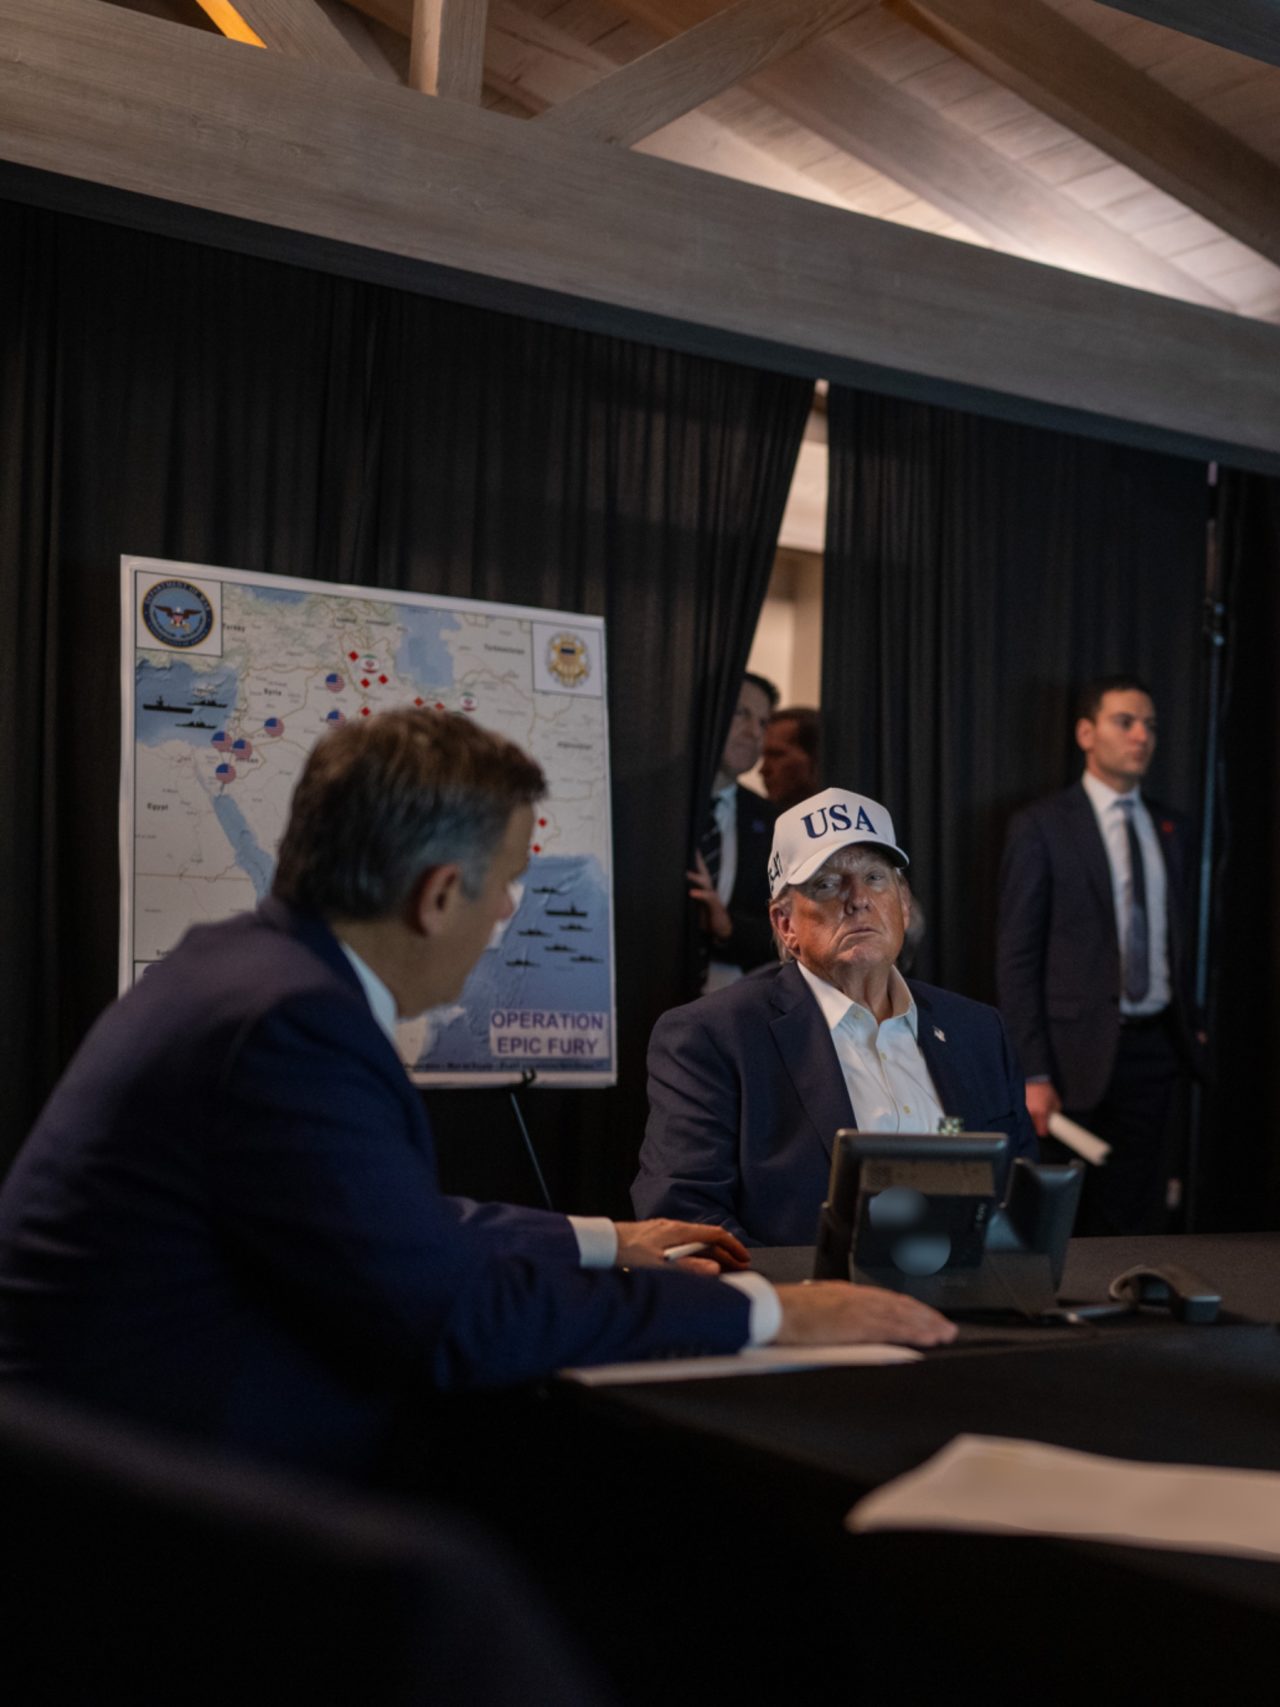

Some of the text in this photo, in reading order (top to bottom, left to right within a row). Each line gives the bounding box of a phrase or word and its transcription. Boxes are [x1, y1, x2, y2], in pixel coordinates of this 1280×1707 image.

[147, 802, 169, 812] Egypt
[801, 803, 877, 839] USA
[491, 1011, 604, 1030] OPERATION
[497, 1037, 599, 1055] EPIC FURY
